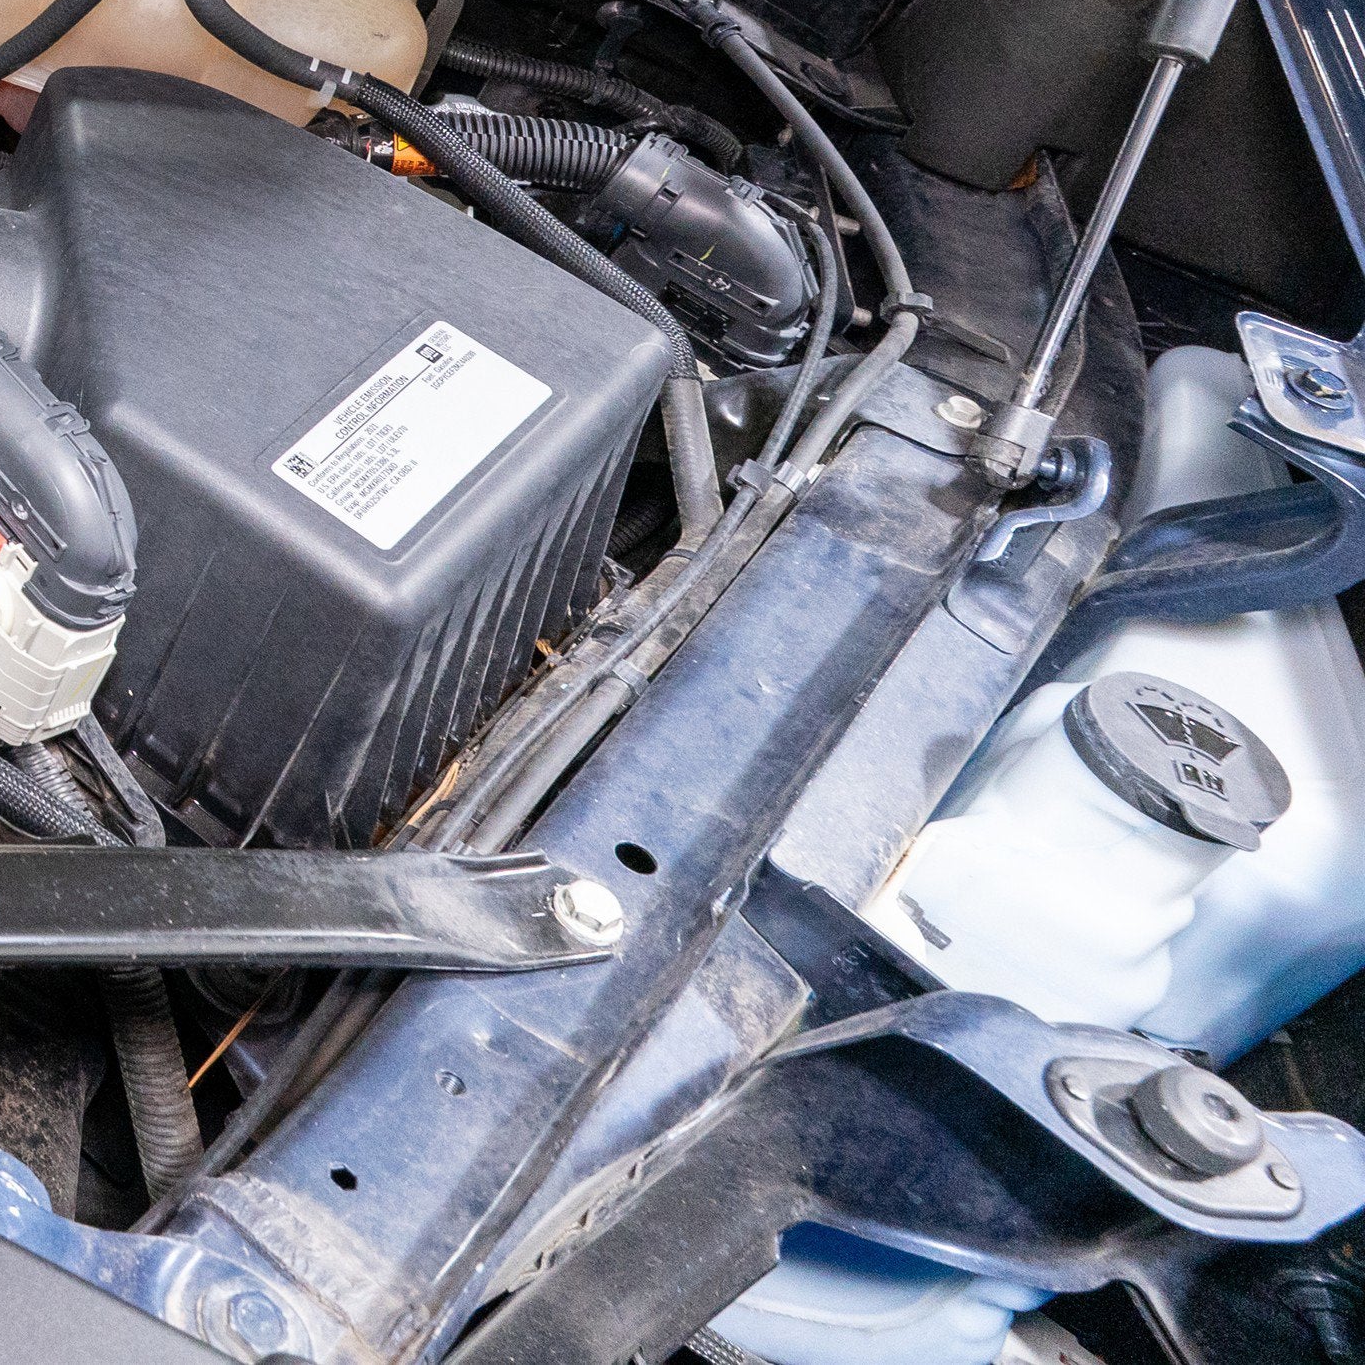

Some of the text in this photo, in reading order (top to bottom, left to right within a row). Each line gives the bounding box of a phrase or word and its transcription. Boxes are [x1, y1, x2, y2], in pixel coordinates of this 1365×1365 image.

[433, 357, 453, 373] Gasoline
[334, 375, 392, 424] VEHICLE EMISSION
[336, 376, 408, 439] CONTROL INFORMATION
[308, 466, 333, 487] Conforms
[326, 478, 351, 499] California
[349, 467, 363, 479] class
[376, 443, 388, 454] LDT
[327, 473, 340, 484] EPA
[338, 463, 353, 475] class
[365, 438, 377, 449] LDT
[376, 424, 393, 438] TIER3
[390, 476, 401, 484] CA
